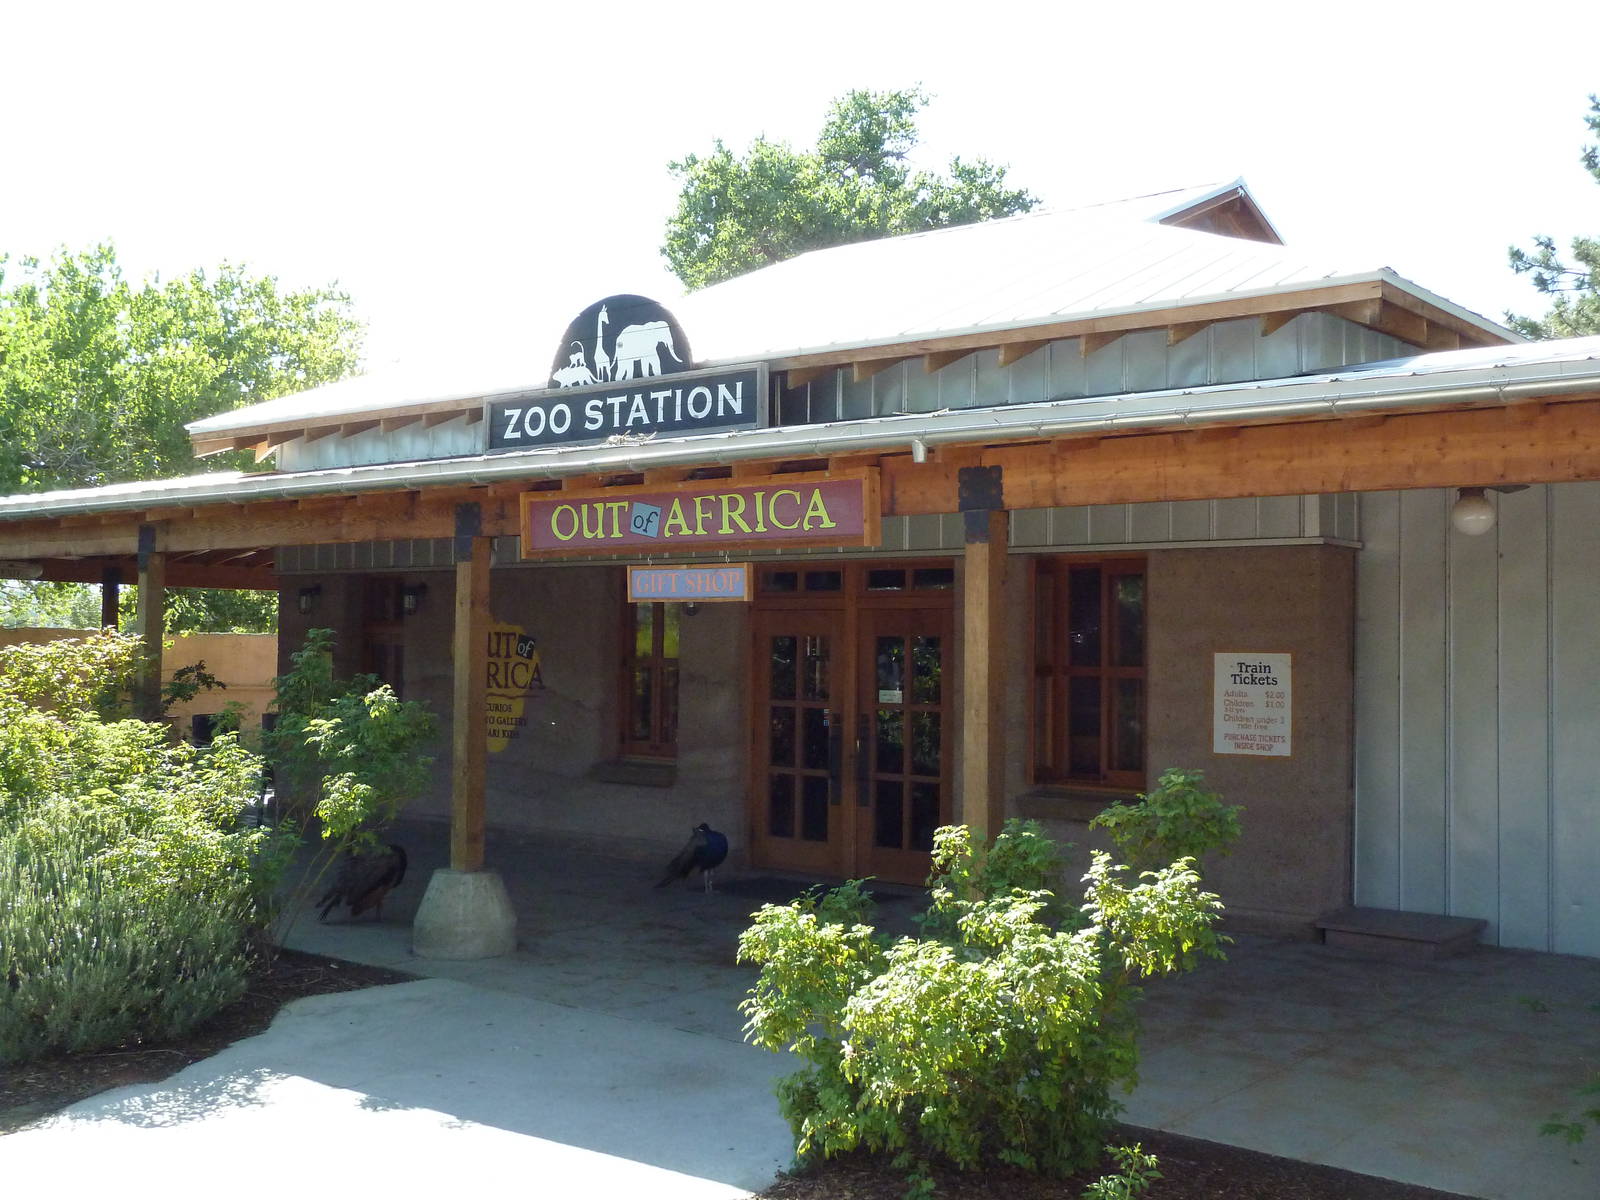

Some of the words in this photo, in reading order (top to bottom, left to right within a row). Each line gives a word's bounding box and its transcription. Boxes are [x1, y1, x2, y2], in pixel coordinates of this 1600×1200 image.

[503, 403, 572, 440] ZOO
[583, 381, 743, 431] STATION
[550, 501, 629, 541] OUT
[633, 511, 659, 533] of
[663, 488, 837, 538] AFRICA
[636, 573, 679, 593] GIFT
[685, 571, 740, 593] SHOP
[487, 631, 517, 658] UT
[517, 640, 535, 658] of
[1237, 662, 1271, 674] Train
[487, 661, 547, 690] RICA
[1231, 673, 1278, 686] Tickets
[1224, 690, 1248, 698] Adults
[1265, 691, 1286, 700] $2.00
[1224, 699, 1255, 708] Children
[1265, 700, 1286, 709] $1.00
[1224, 713, 1254, 723] Children
[1256, 716, 1278, 725] under
[1224, 733, 1257, 743] PURCHASE
[1258, 735, 1287, 744] TICKETS
[1234, 742, 1255, 751] INSIDE
[1256, 743, 1274, 752] SHOP
